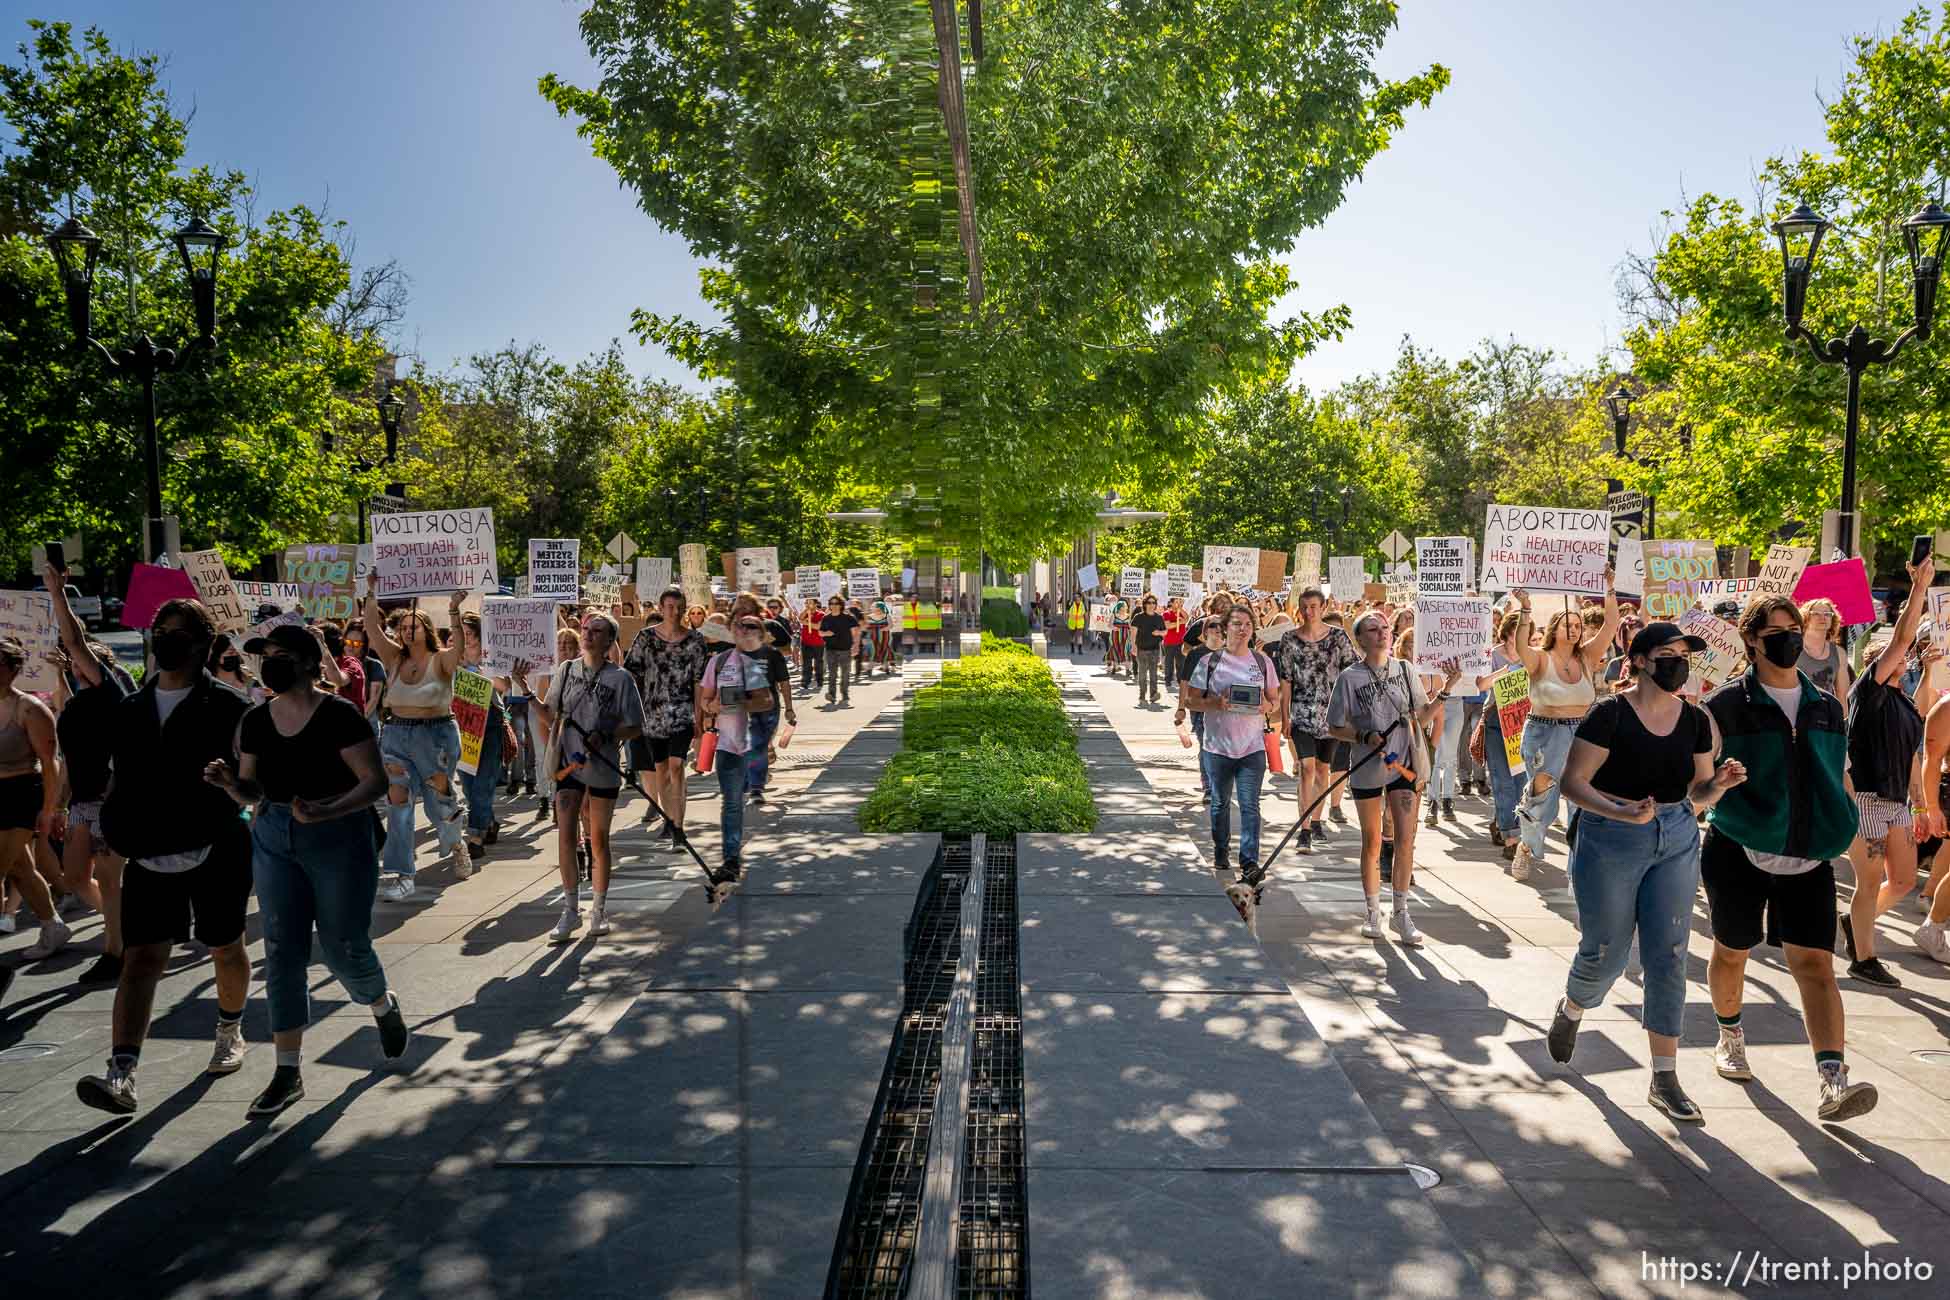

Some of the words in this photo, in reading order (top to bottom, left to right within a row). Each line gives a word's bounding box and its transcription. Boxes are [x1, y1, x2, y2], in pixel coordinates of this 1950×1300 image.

[1609, 492, 1641, 504] WELCOME
[1616, 500, 1642, 513] PROVO
[1488, 508, 1608, 532] ABORTION
[1432, 540, 1449, 548] THE
[1501, 535, 1513, 548] IS
[1526, 536, 1606, 557] HEALTHCARE
[1662, 542, 1696, 558] MY
[1422, 549, 1459, 558] SYSTEM
[1490, 550, 1565, 566] HEALTHCARE
[1570, 554, 1583, 566] IS
[1419, 558, 1428, 567] IS
[1428, 558, 1463, 567] SEXIST!
[1651, 557, 1714, 582] BODY
[1421, 572, 1444, 582] FIGHT
[1444, 573, 1460, 582] FOR
[1764, 564, 1791, 580] NOT
[1484, 566, 1499, 584] A
[1506, 567, 1558, 584] HUMAN
[1563, 569, 1606, 593] RIGHT
[1418, 582, 1463, 592] SOCIALISM!
[1700, 581, 1722, 594] MY
[1756, 580, 1790, 594] ABOUT
[1416, 600, 1491, 614] VASECTOMIES
[1440, 617, 1479, 630] PREVENT
[1426, 632, 1487, 648] ABORTION
[1685, 622, 1744, 659] AUTONOMY
